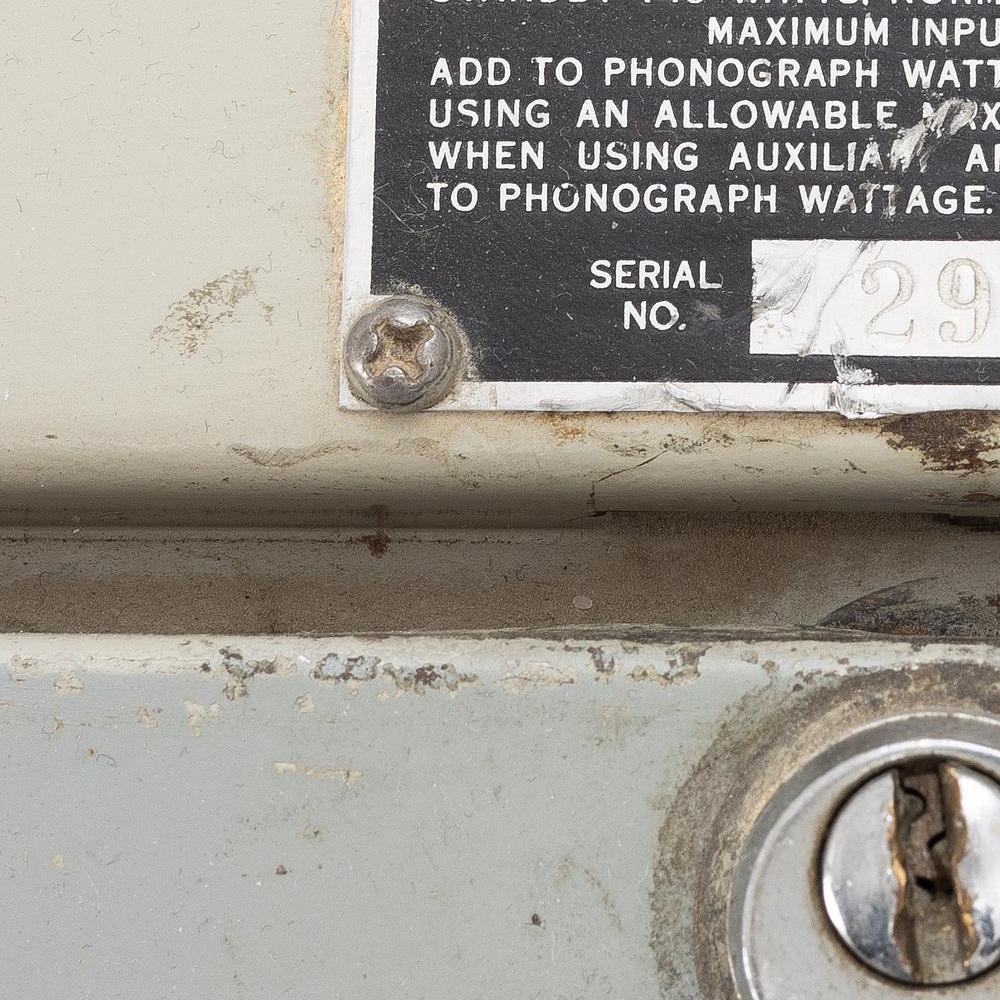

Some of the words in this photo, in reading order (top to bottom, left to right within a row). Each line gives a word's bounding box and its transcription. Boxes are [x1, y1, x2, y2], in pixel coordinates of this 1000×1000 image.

[707, 13, 889, 46] MAXIMUM
[430, 56, 511, 87] ADD
[531, 56, 583, 86] TO
[604, 56, 878, 88] PHONOGRAPH
[429, 98, 550, 129] USING
[576, 99, 629, 129] AN
[654, 99, 898, 130] ALLOWABLE
[428, 140, 544, 170] WHEN
[578, 140, 699, 172] USING
[729, 141, 928, 172] AUXILIA
[426, 182, 478, 212] TO
[499, 182, 777, 214] PHONOGRAPH
[589, 259, 722, 290] SERIAL
[623, 300, 687, 331] NO.
